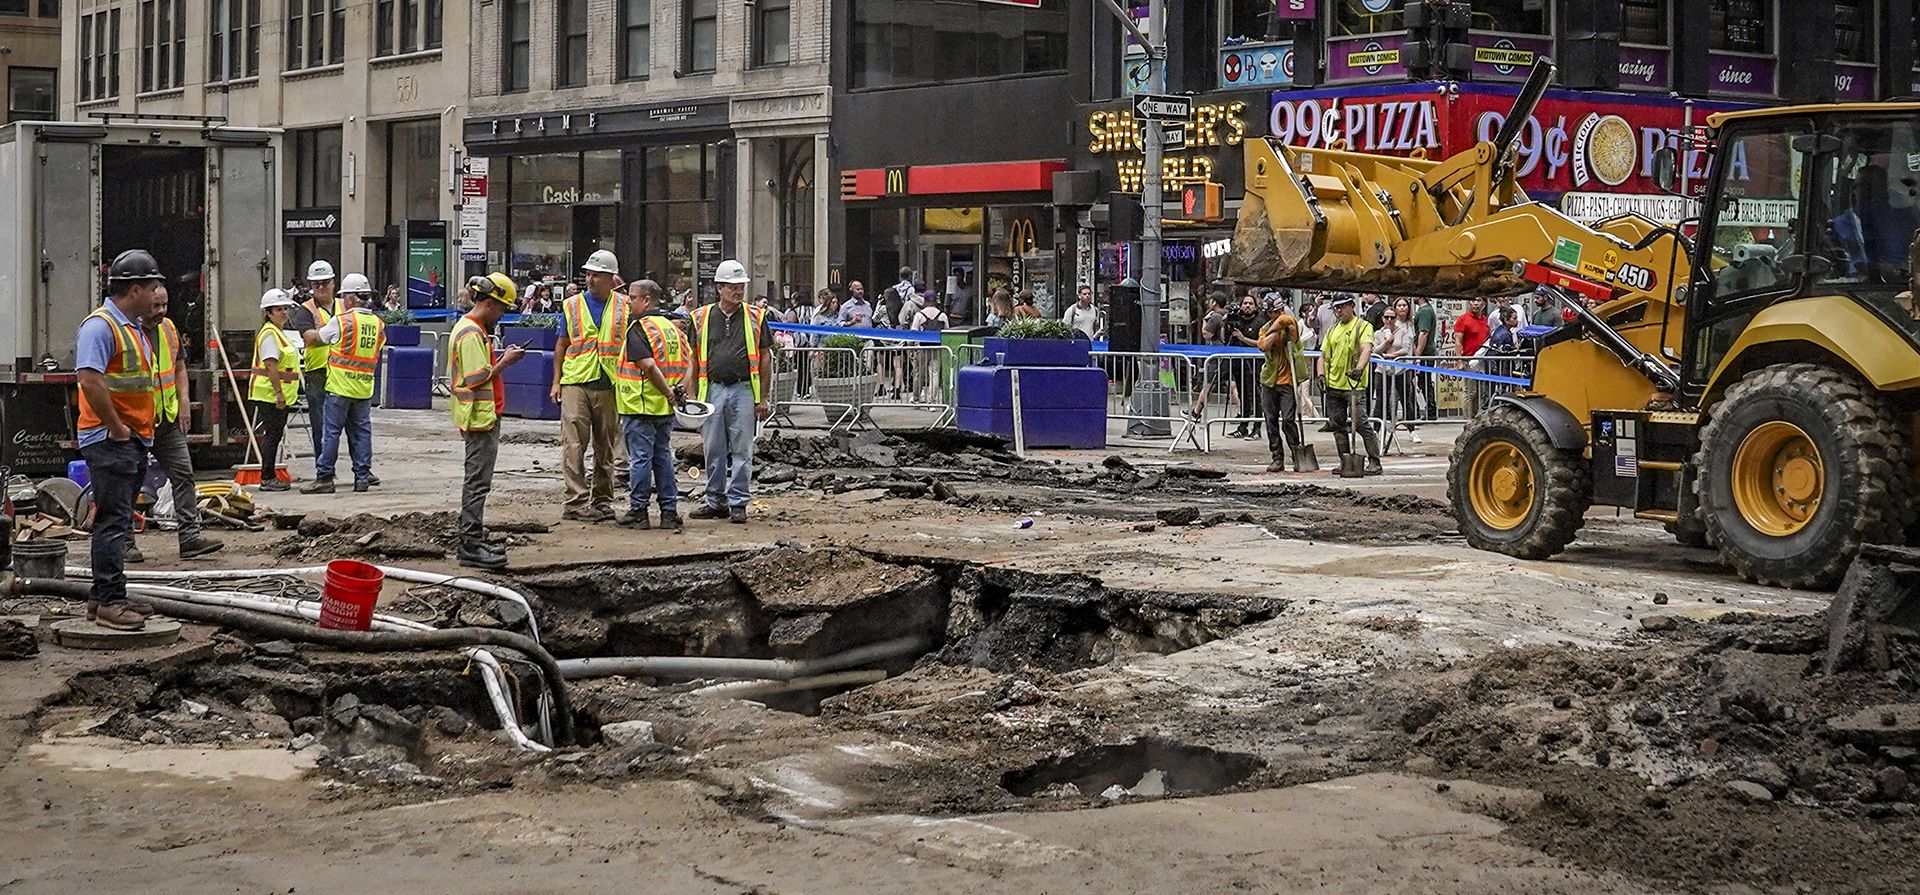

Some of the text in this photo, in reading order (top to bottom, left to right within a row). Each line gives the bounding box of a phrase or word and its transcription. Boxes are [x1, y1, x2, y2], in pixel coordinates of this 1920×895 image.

[1350, 51, 1398, 65] MIDTOWN COMICS
[1477, 50, 1532, 63] MIDTOWN COMICS
[1718, 64, 1753, 84] since
[397, 75, 419, 104] 550
[1142, 102, 1184, 114] ONE WAY
[1088, 100, 1248, 154] SMOER'S
[1270, 98, 1341, 150] 99¢
[1344, 99, 1438, 150] PIZZA
[1165, 131, 1180, 143] WAY
[1575, 114, 1598, 183] DELICIOUS
[1640, 127, 1751, 180] PIZA
[1116, 154, 1214, 193] WRLD
[1567, 195, 1586, 217] PIZZA
[1589, 196, 1610, 218] PASTA
[1203, 238, 1232, 259] OPEN
[1617, 263, 1650, 290] 450
[361, 323, 377, 337] NYC
[360, 336, 377, 349] DEP
[666, 341, 679, 355] DEP
[324, 594, 361, 612] HARBOR
